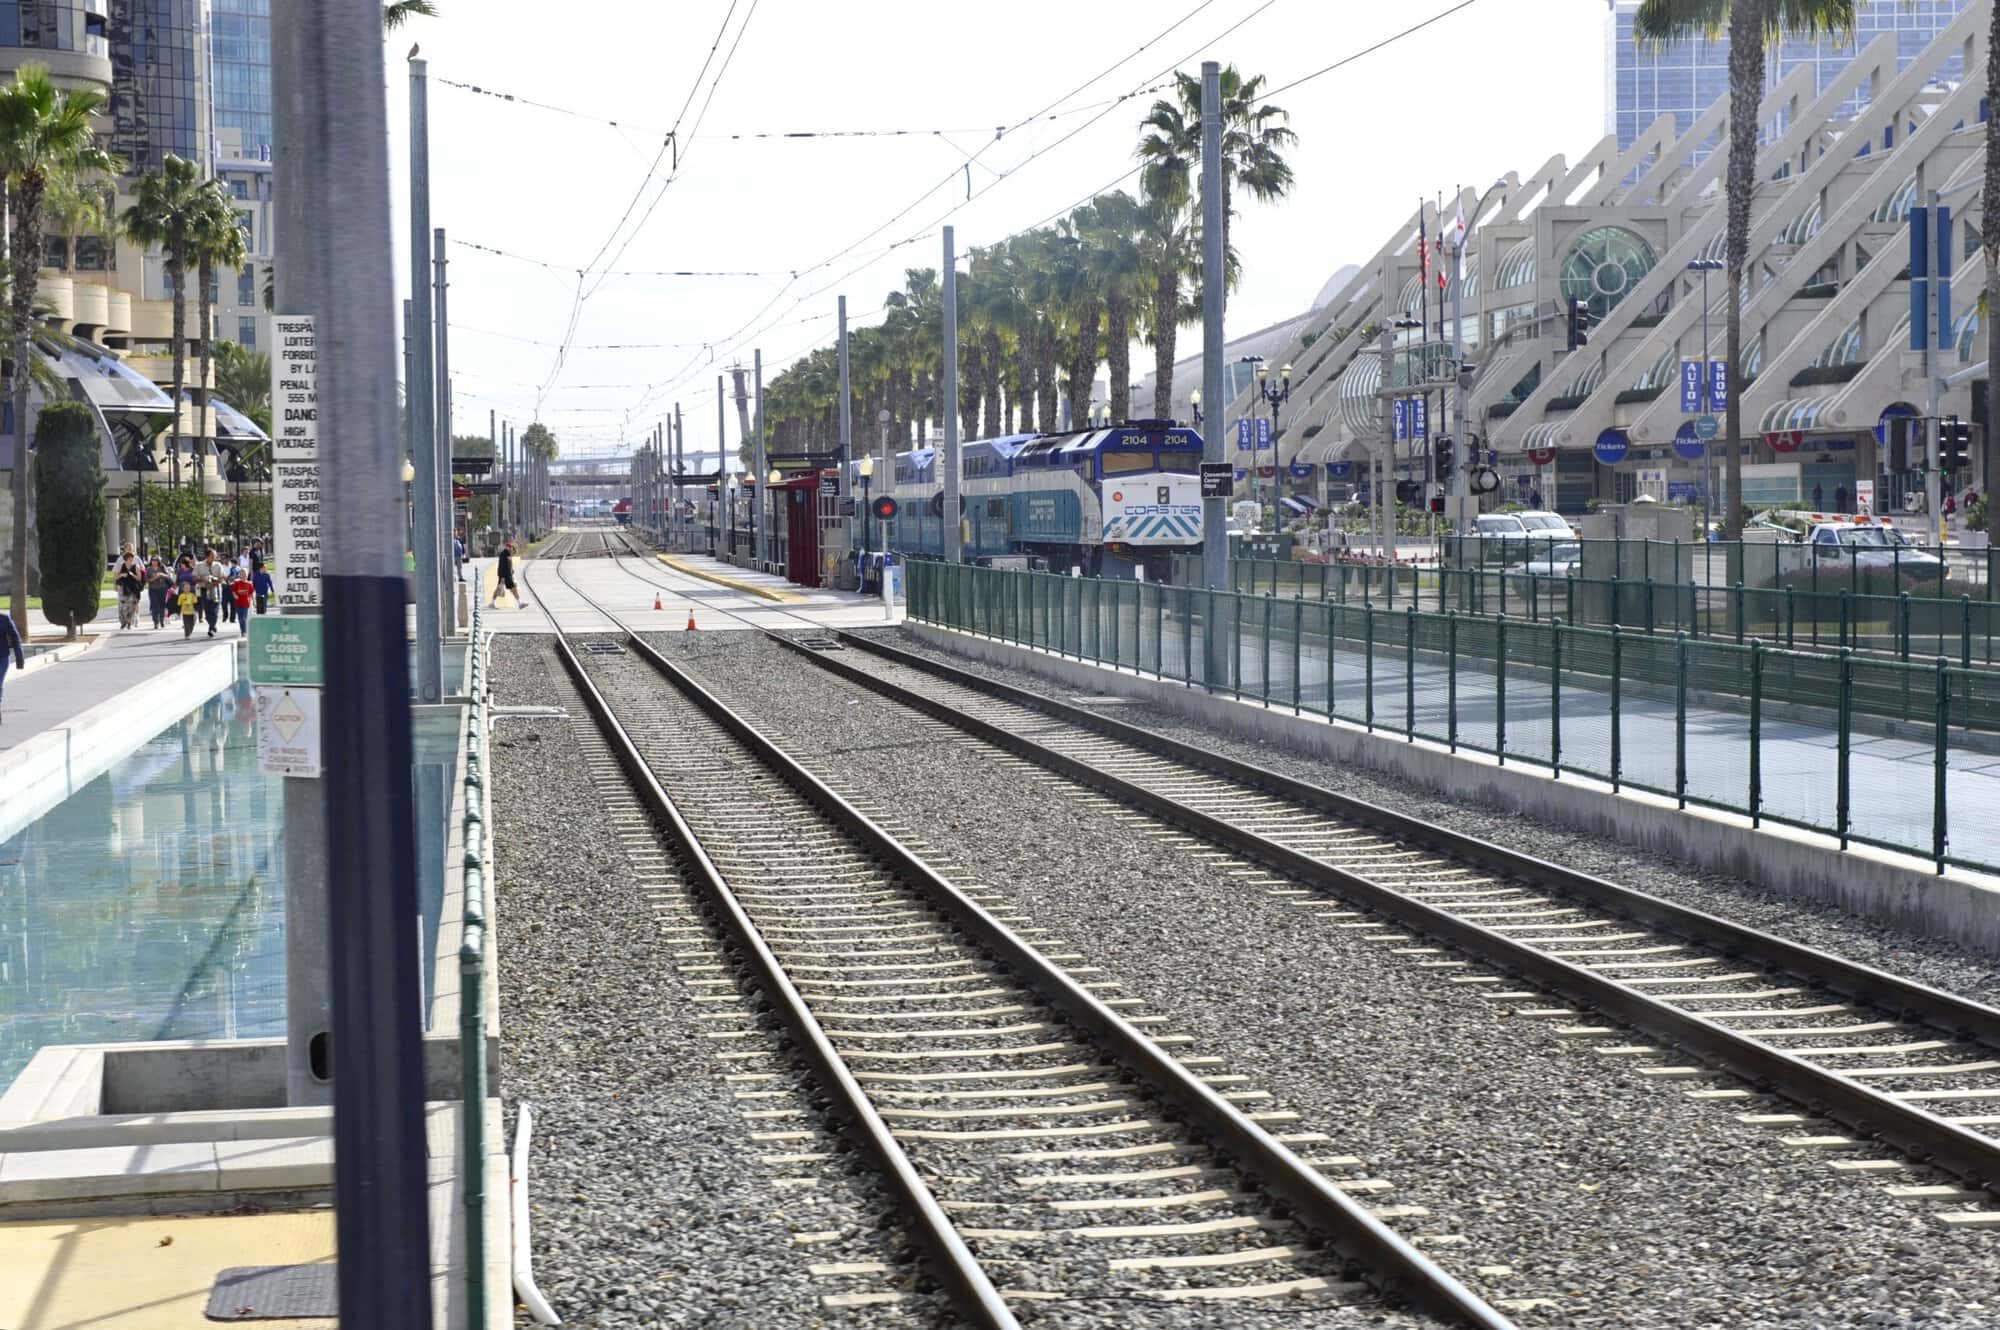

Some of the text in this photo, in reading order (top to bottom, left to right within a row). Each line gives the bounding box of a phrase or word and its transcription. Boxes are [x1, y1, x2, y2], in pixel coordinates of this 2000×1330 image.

[277, 323, 316, 333] TRESPA
[290, 364, 303, 374] BY
[280, 380, 311, 390] PENAL
[1687, 363, 1697, 400] AUTO
[1715, 362, 1727, 400] SHOW
[288, 393, 306, 403] 555
[284, 427, 306, 436] HIGH
[276, 439, 316, 449] VOLTAGE
[1122, 436, 1147, 445] 2104
[1164, 436, 1188, 445] 2104
[1124, 505, 1200, 515] COASTER
[290, 515, 309, 525] POR
[289, 553, 307, 563] 555
[287, 582, 308, 592] ALTO
[279, 594, 317, 604] VOLTAJE
[271, 633, 300, 642] PARK
[265, 643, 307, 654] CLOSED
[271, 654, 302, 664] DAILY
